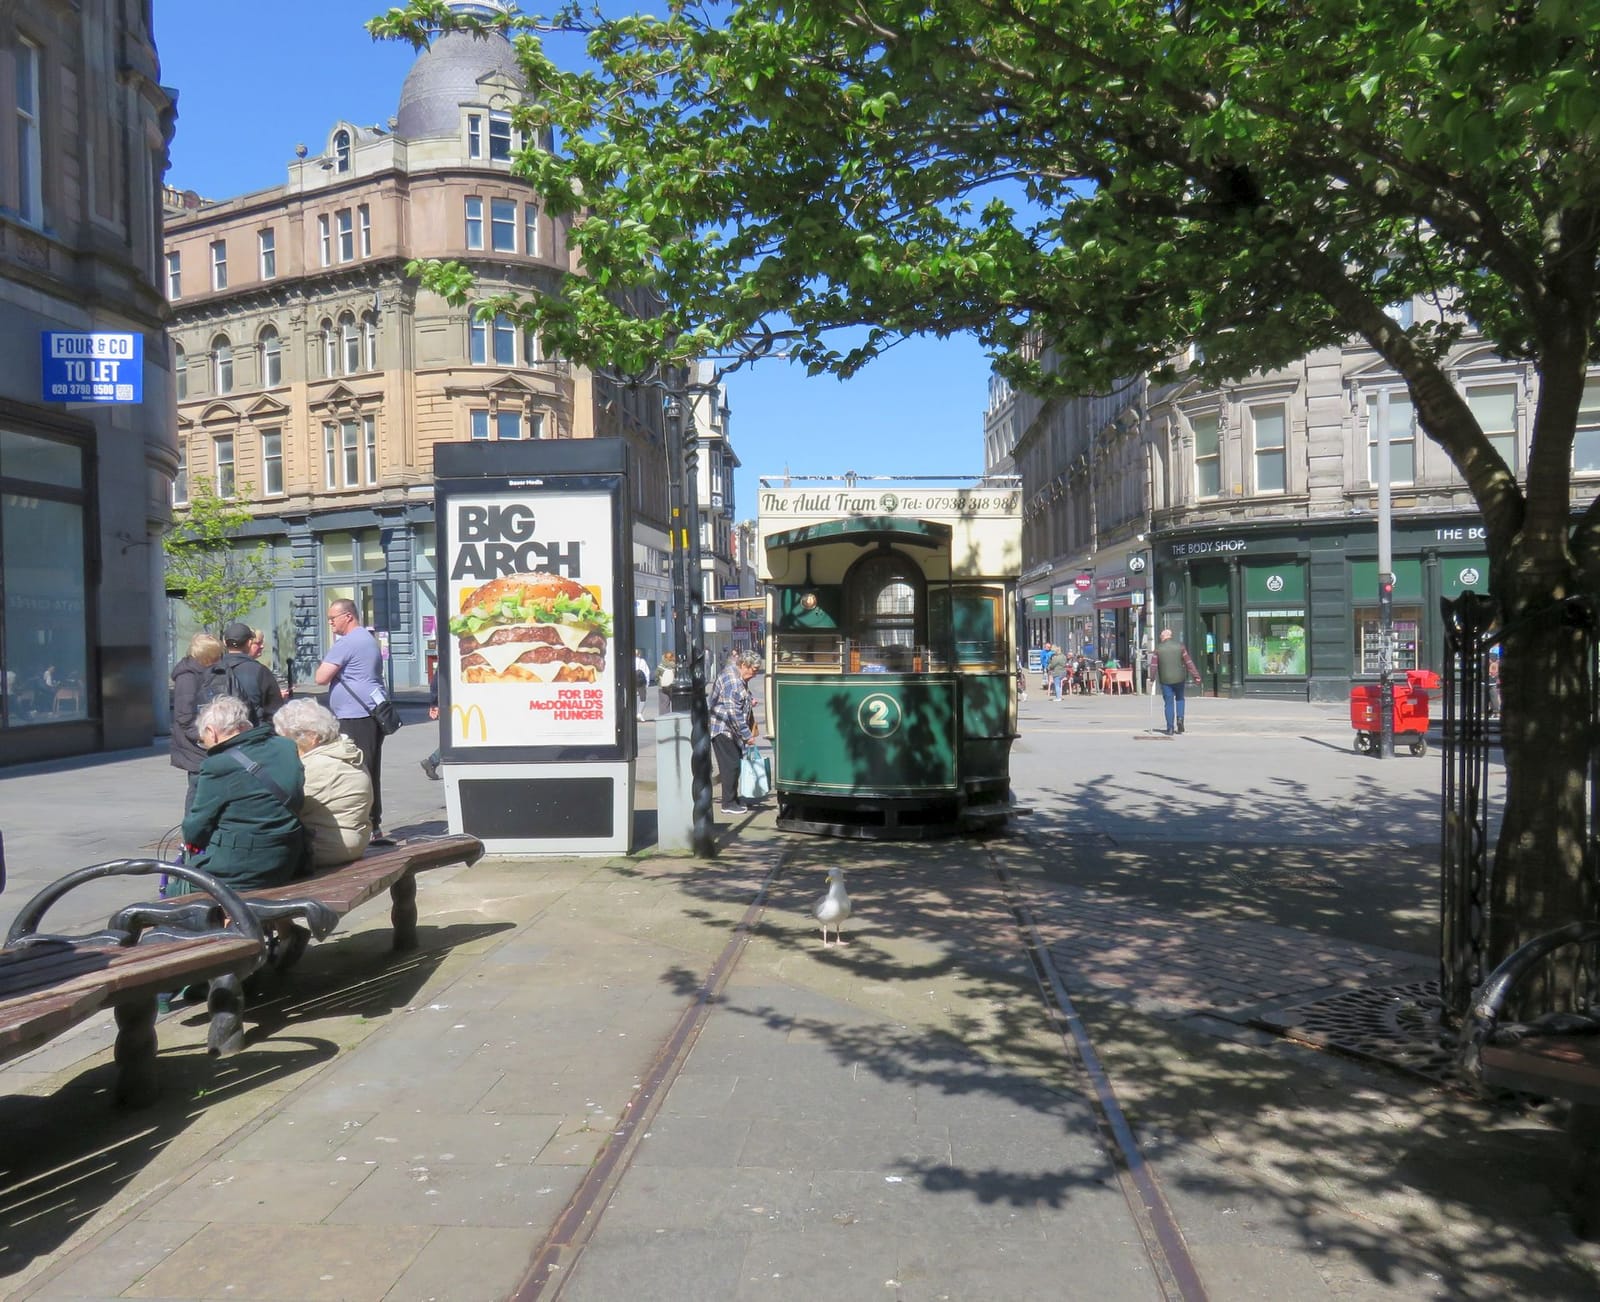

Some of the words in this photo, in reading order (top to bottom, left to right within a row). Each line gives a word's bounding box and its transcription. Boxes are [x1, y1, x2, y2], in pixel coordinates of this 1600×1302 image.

[57, 338, 94, 354] FOUR
[97, 338, 105, 354] &
[109, 338, 127, 354] CO
[65, 361, 85, 382] TO
[90, 361, 120, 382] LET
[762, 493, 788, 511] The
[793, 493, 831, 513] Auld
[835, 493, 876, 511] Tram
[901, 497, 922, 510] Tel:
[968, 497, 990, 510] 318
[458, 504, 536, 543] BIG
[1435, 528, 1463, 540] THE
[1172, 544, 1186, 555] THE
[1188, 541, 1213, 554] BODY
[451, 541, 581, 581] ARCH
[558, 689, 581, 699] FOR
[583, 689, 603, 699] BIG
[529, 700, 604, 710] McDONALD'S
[553, 710, 604, 720] HUNGER
[868, 700, 889, 729] 2
